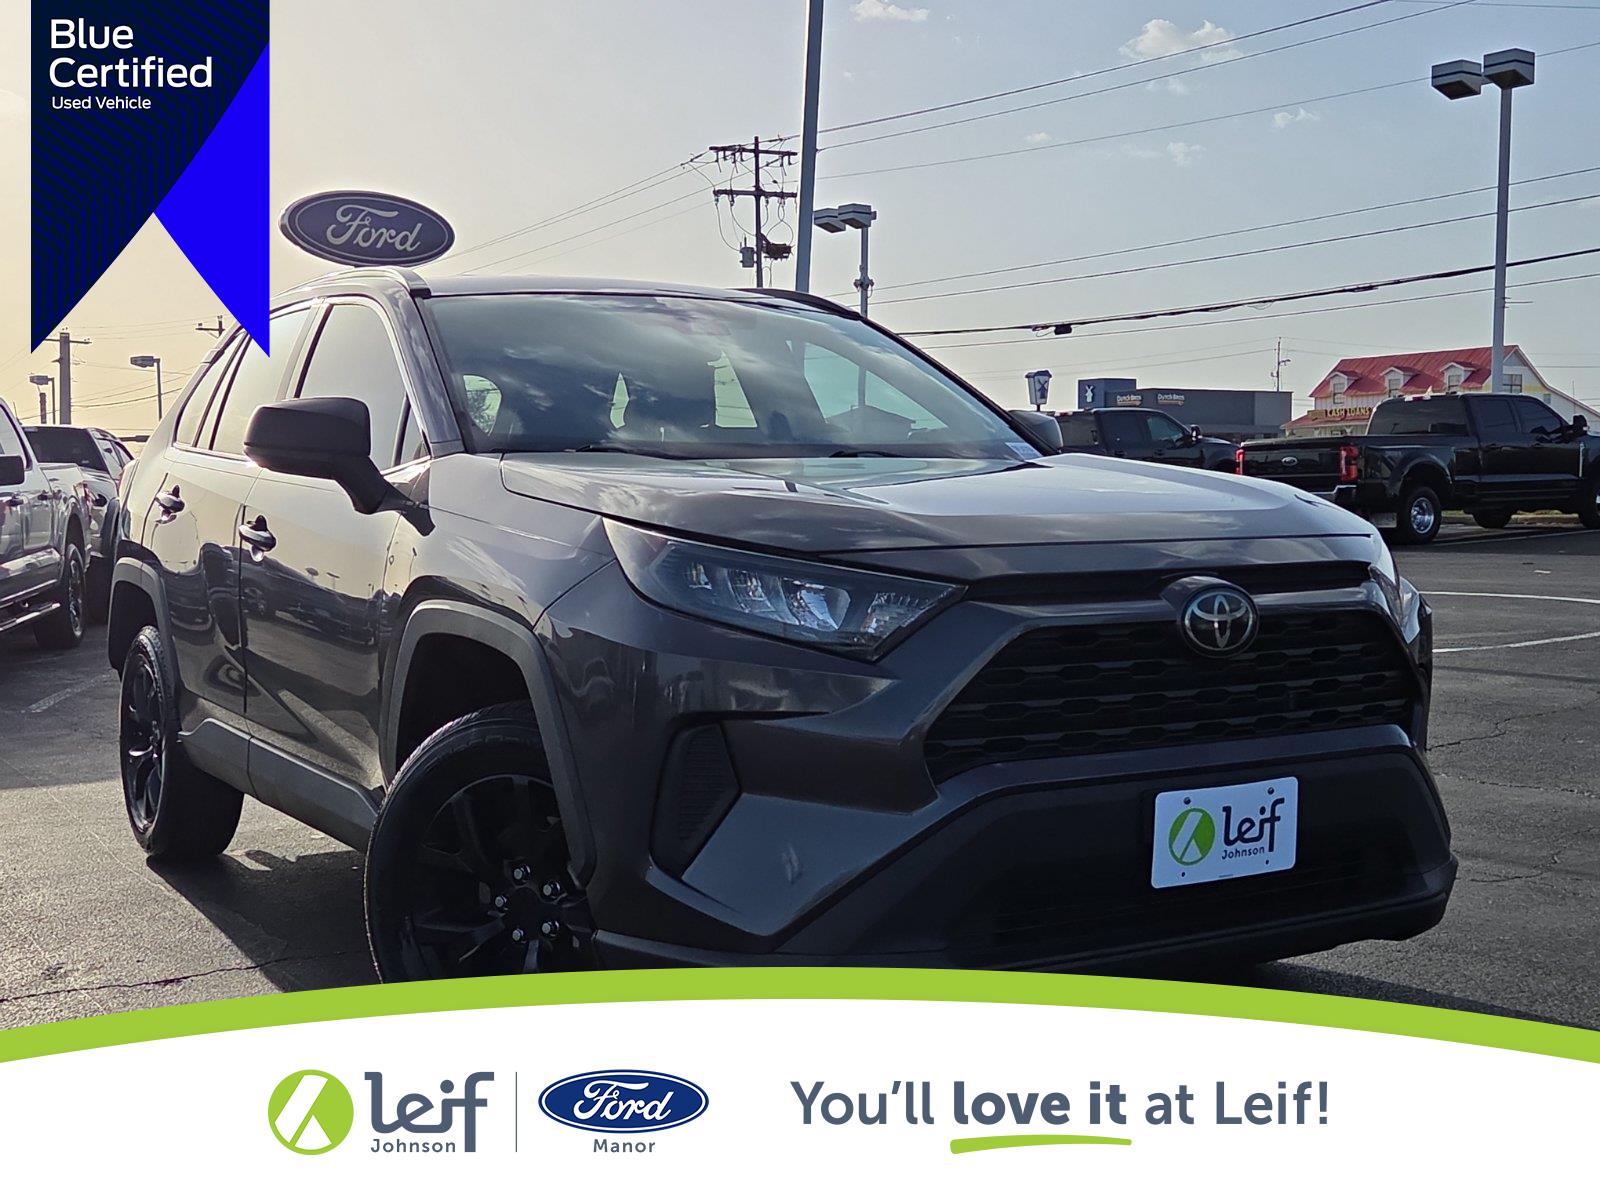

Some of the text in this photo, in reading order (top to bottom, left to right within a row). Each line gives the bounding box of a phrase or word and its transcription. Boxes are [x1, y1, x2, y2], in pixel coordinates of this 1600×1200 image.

[326, 204, 421, 252] Ford
[1328, 408, 1346, 417] CASH
[1348, 407, 1370, 417] LOANS
[1221, 846, 1265, 860] Johnson
